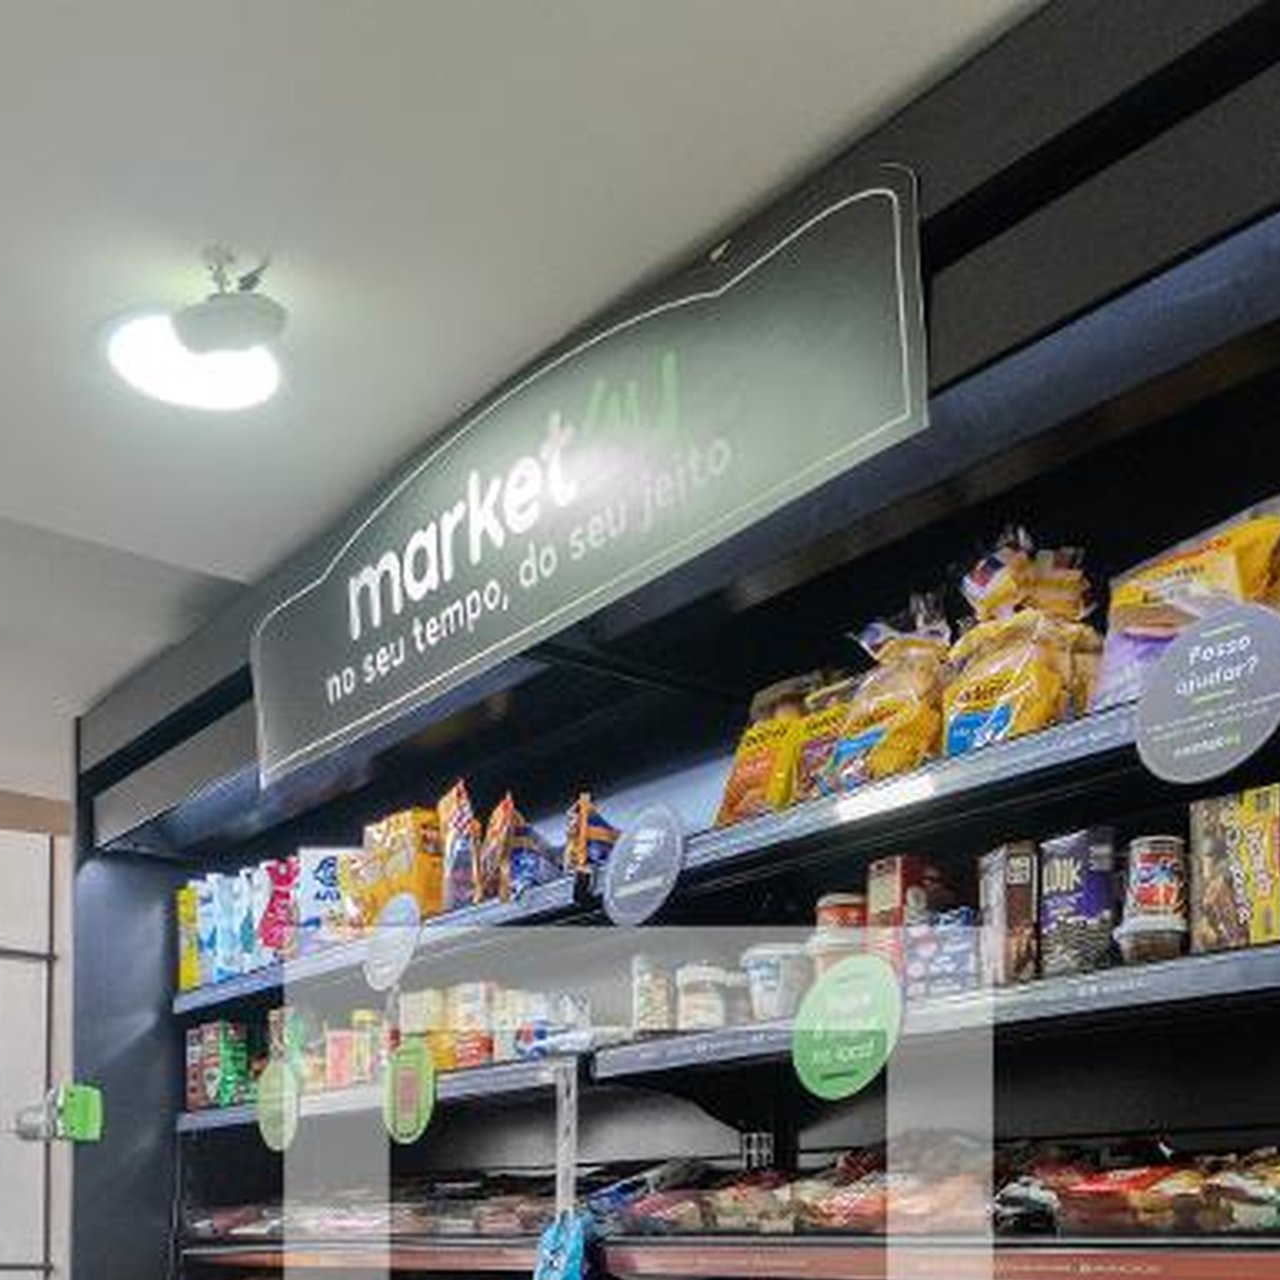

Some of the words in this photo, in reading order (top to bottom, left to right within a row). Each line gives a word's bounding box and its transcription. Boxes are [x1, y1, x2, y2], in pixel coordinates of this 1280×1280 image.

[327, 662, 355, 703] no
[363, 636, 406, 678] seu
[412, 577, 511, 652] tempo,
[519, 540, 558, 589] do
[570, 503, 628, 560] seu
[640, 436, 732, 534] jeito
[1188, 636, 1252, 666] Posso
